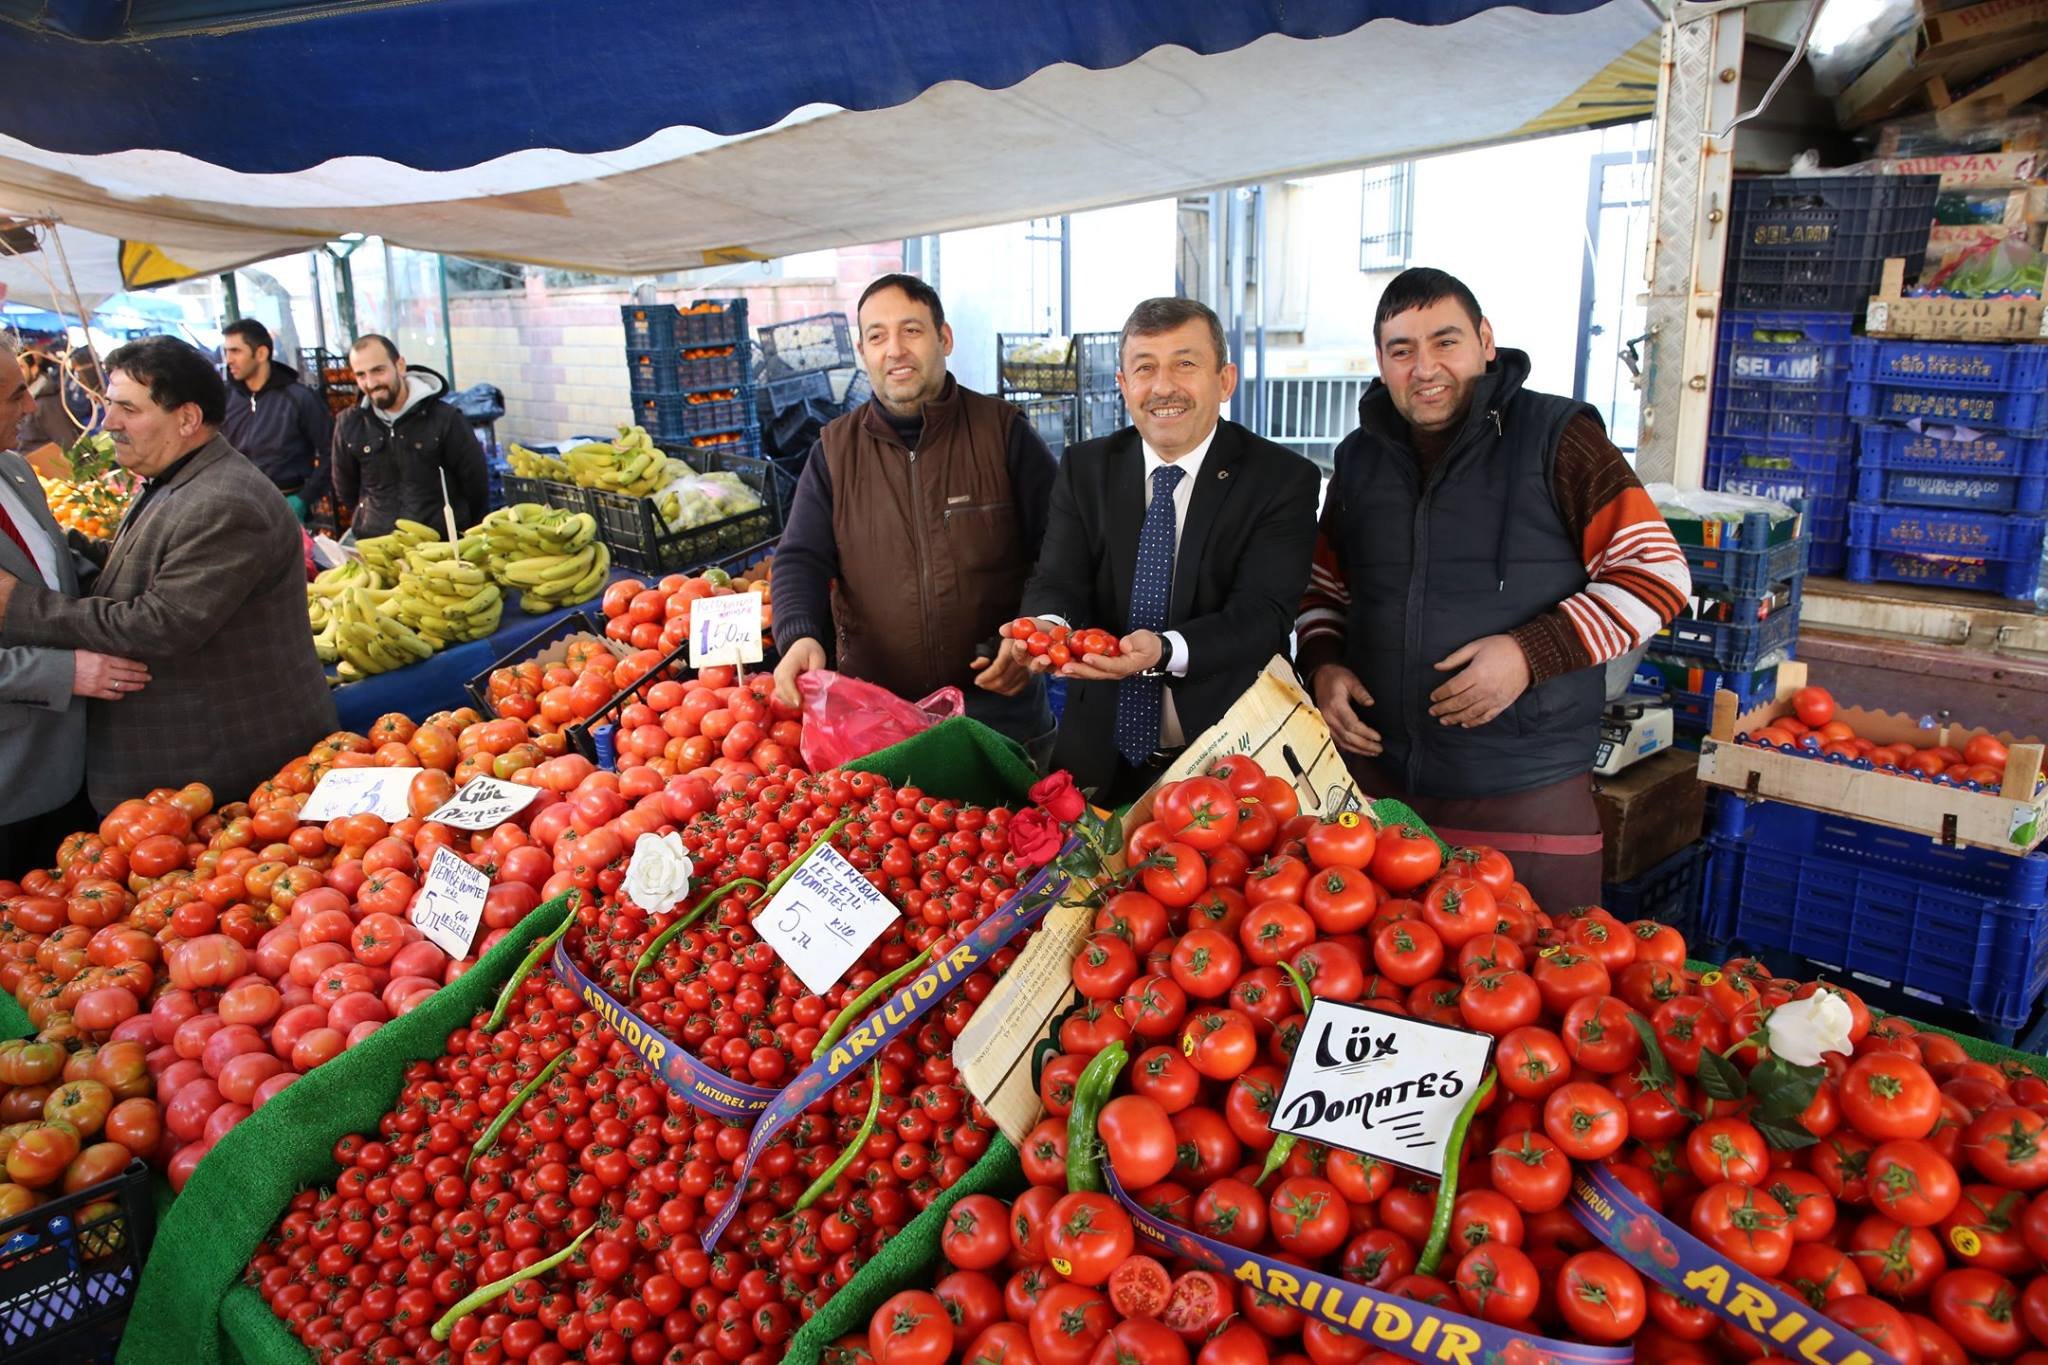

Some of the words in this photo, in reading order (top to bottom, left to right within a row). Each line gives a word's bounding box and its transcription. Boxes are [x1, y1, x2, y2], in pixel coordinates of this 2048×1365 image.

[583, 985, 666, 1070] ARILIDIR
[828, 945, 978, 1075] ARILIDIR
[695, 1081, 745, 1109] NATUREL
[1233, 1259, 1482, 1365] ARILIDIR
